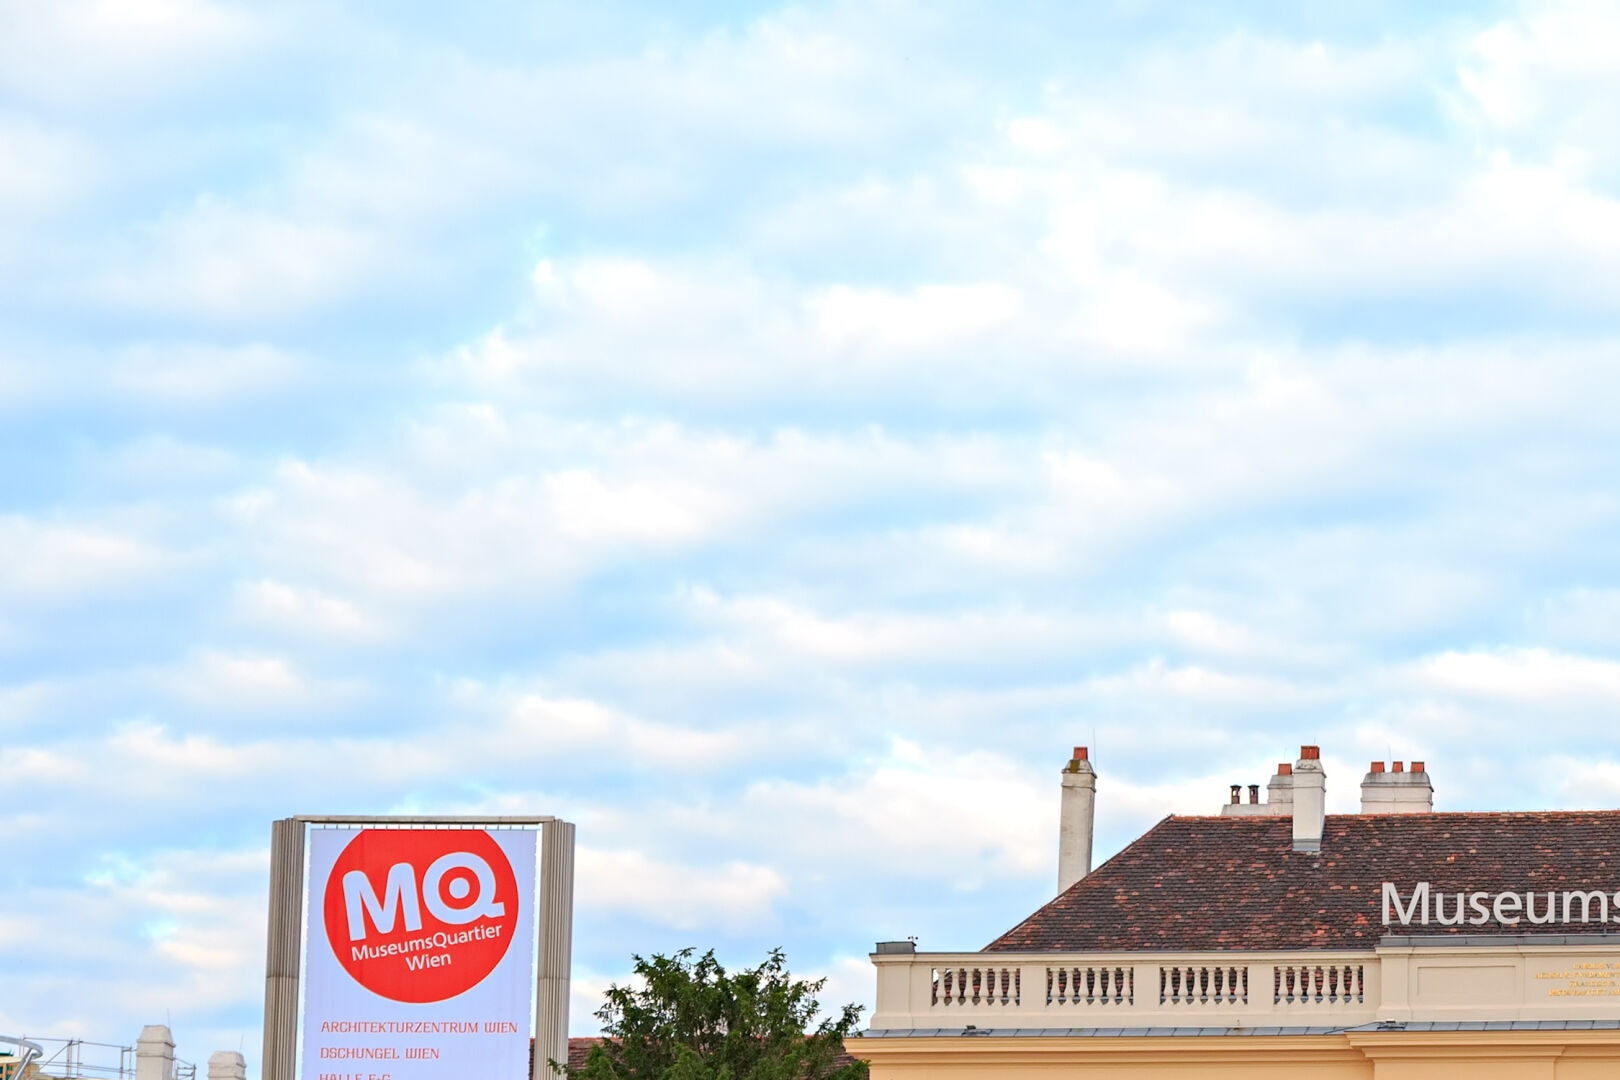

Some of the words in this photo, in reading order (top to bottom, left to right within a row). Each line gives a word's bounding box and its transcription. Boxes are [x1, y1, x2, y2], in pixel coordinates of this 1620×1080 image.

[342, 851, 506, 941] MQ
[351, 924, 503, 961] MuseumsQuartier
[405, 952, 452, 971] Wien
[320, 1021, 479, 1034] ARCHITEKTURZENTRUM
[484, 1021, 519, 1034] WIEN
[319, 1047, 400, 1060] DSCHUNGEL
[405, 1048, 440, 1060] WIEN
